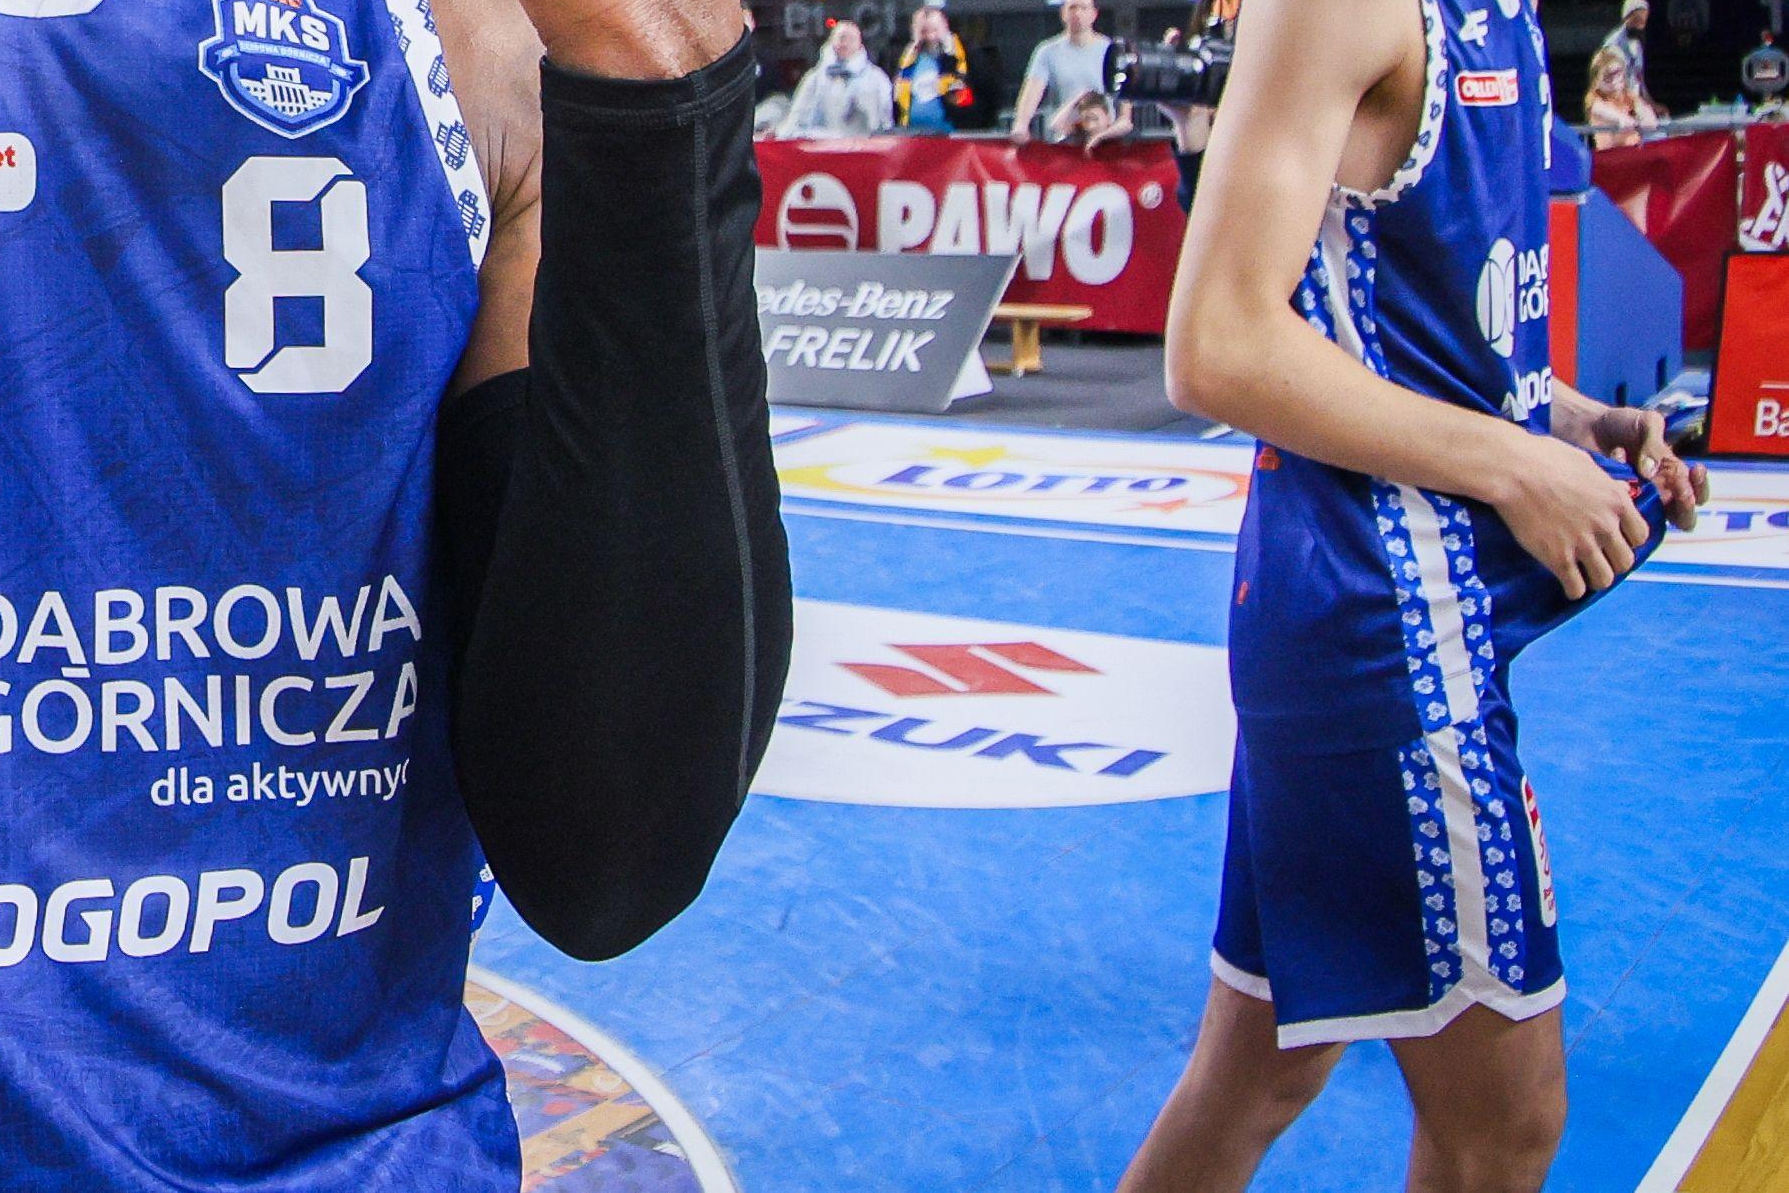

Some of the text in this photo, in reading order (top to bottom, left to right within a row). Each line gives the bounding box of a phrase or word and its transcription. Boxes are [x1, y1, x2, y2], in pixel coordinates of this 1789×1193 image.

[233, 0, 330, 51] MKS
[222, 156, 373, 394] 8
[758, 279, 956, 320] edes-Benz
[764, 324, 936, 372] FRELIK
[1753, 398, 1789, 437] Ba
[877, 464, 1189, 494] LOTTO
[777, 700, 1170, 777] ZUKI
[151, 758, 410, 807] dla aktywny
